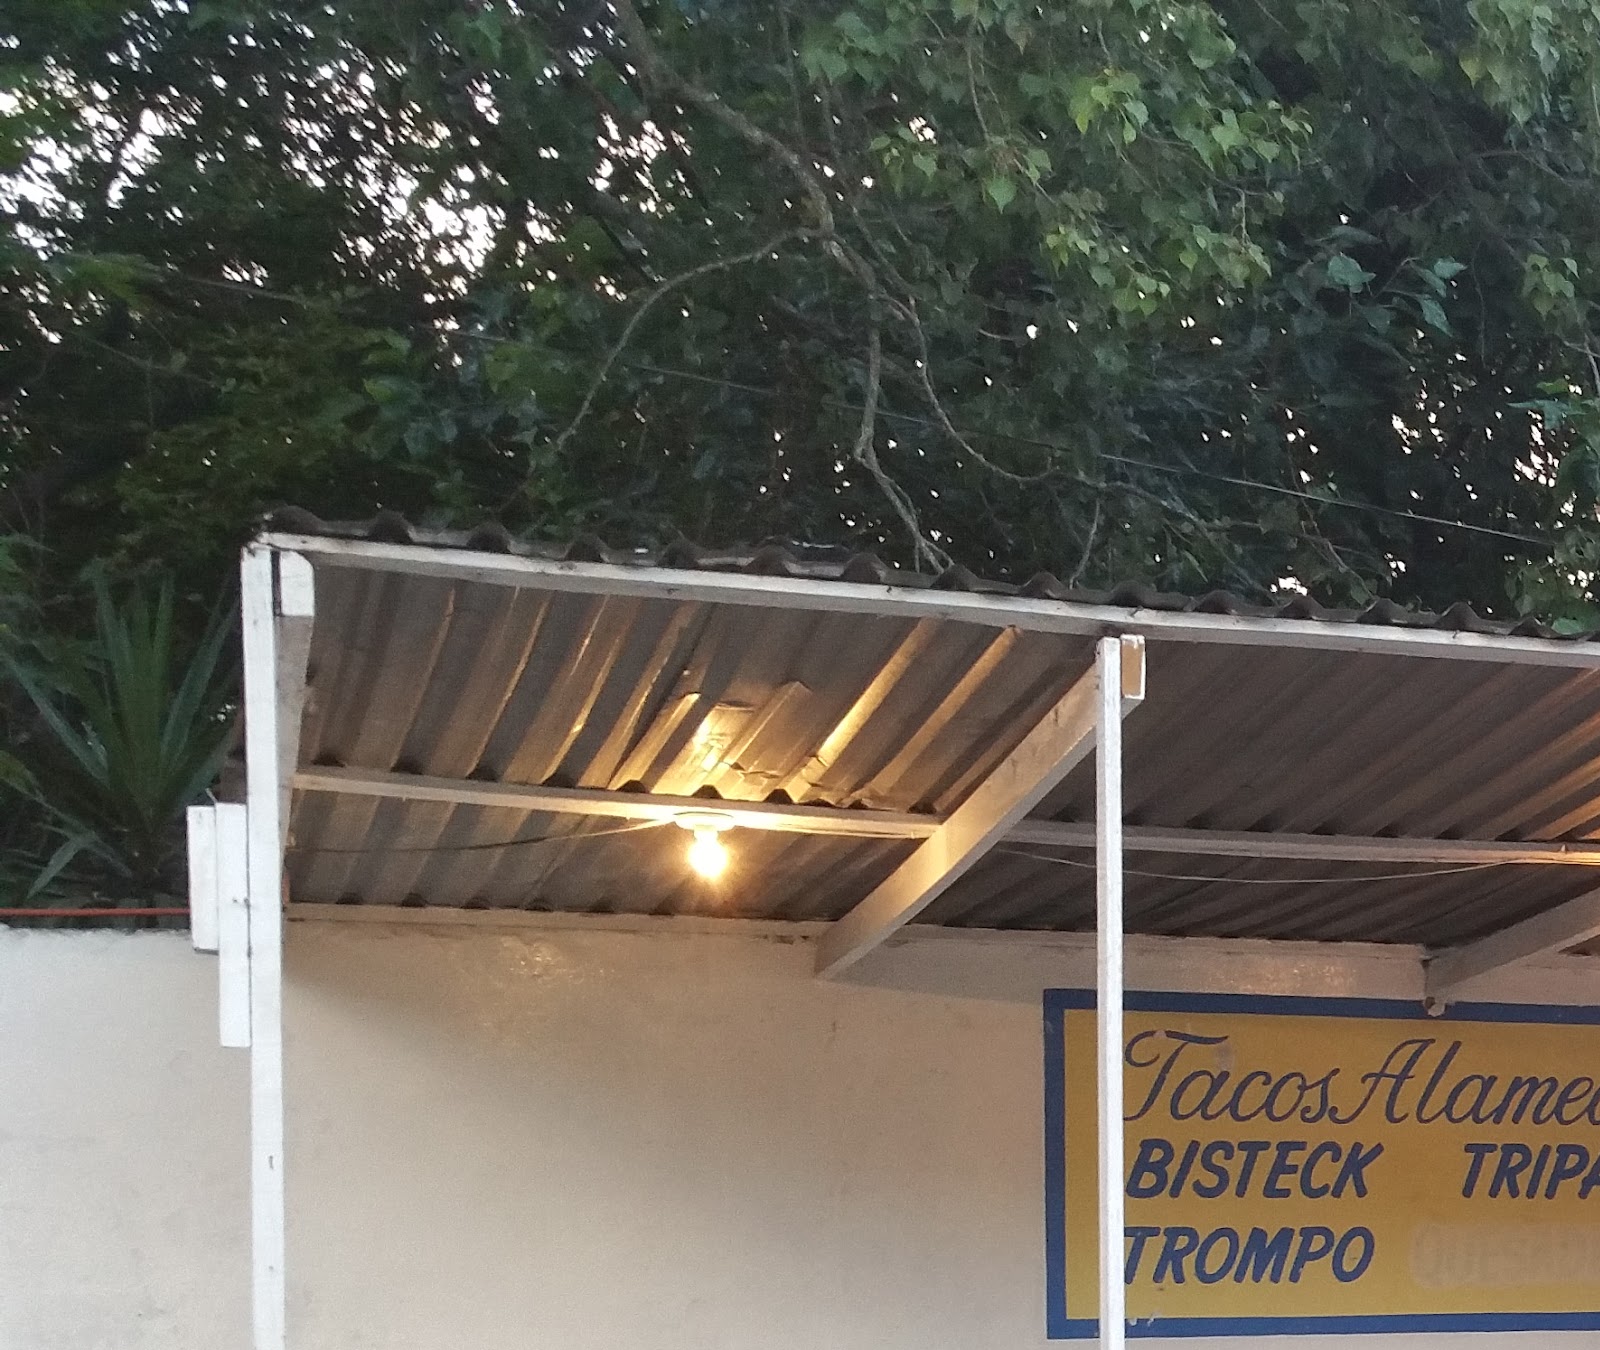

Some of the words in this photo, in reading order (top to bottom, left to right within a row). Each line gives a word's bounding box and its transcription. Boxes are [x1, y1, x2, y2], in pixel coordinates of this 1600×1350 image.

[1124, 1029, 1341, 1124] Tacos
[1125, 1138, 1385, 1199] BISTECK
[1124, 1226, 1376, 1285] TROMPO
